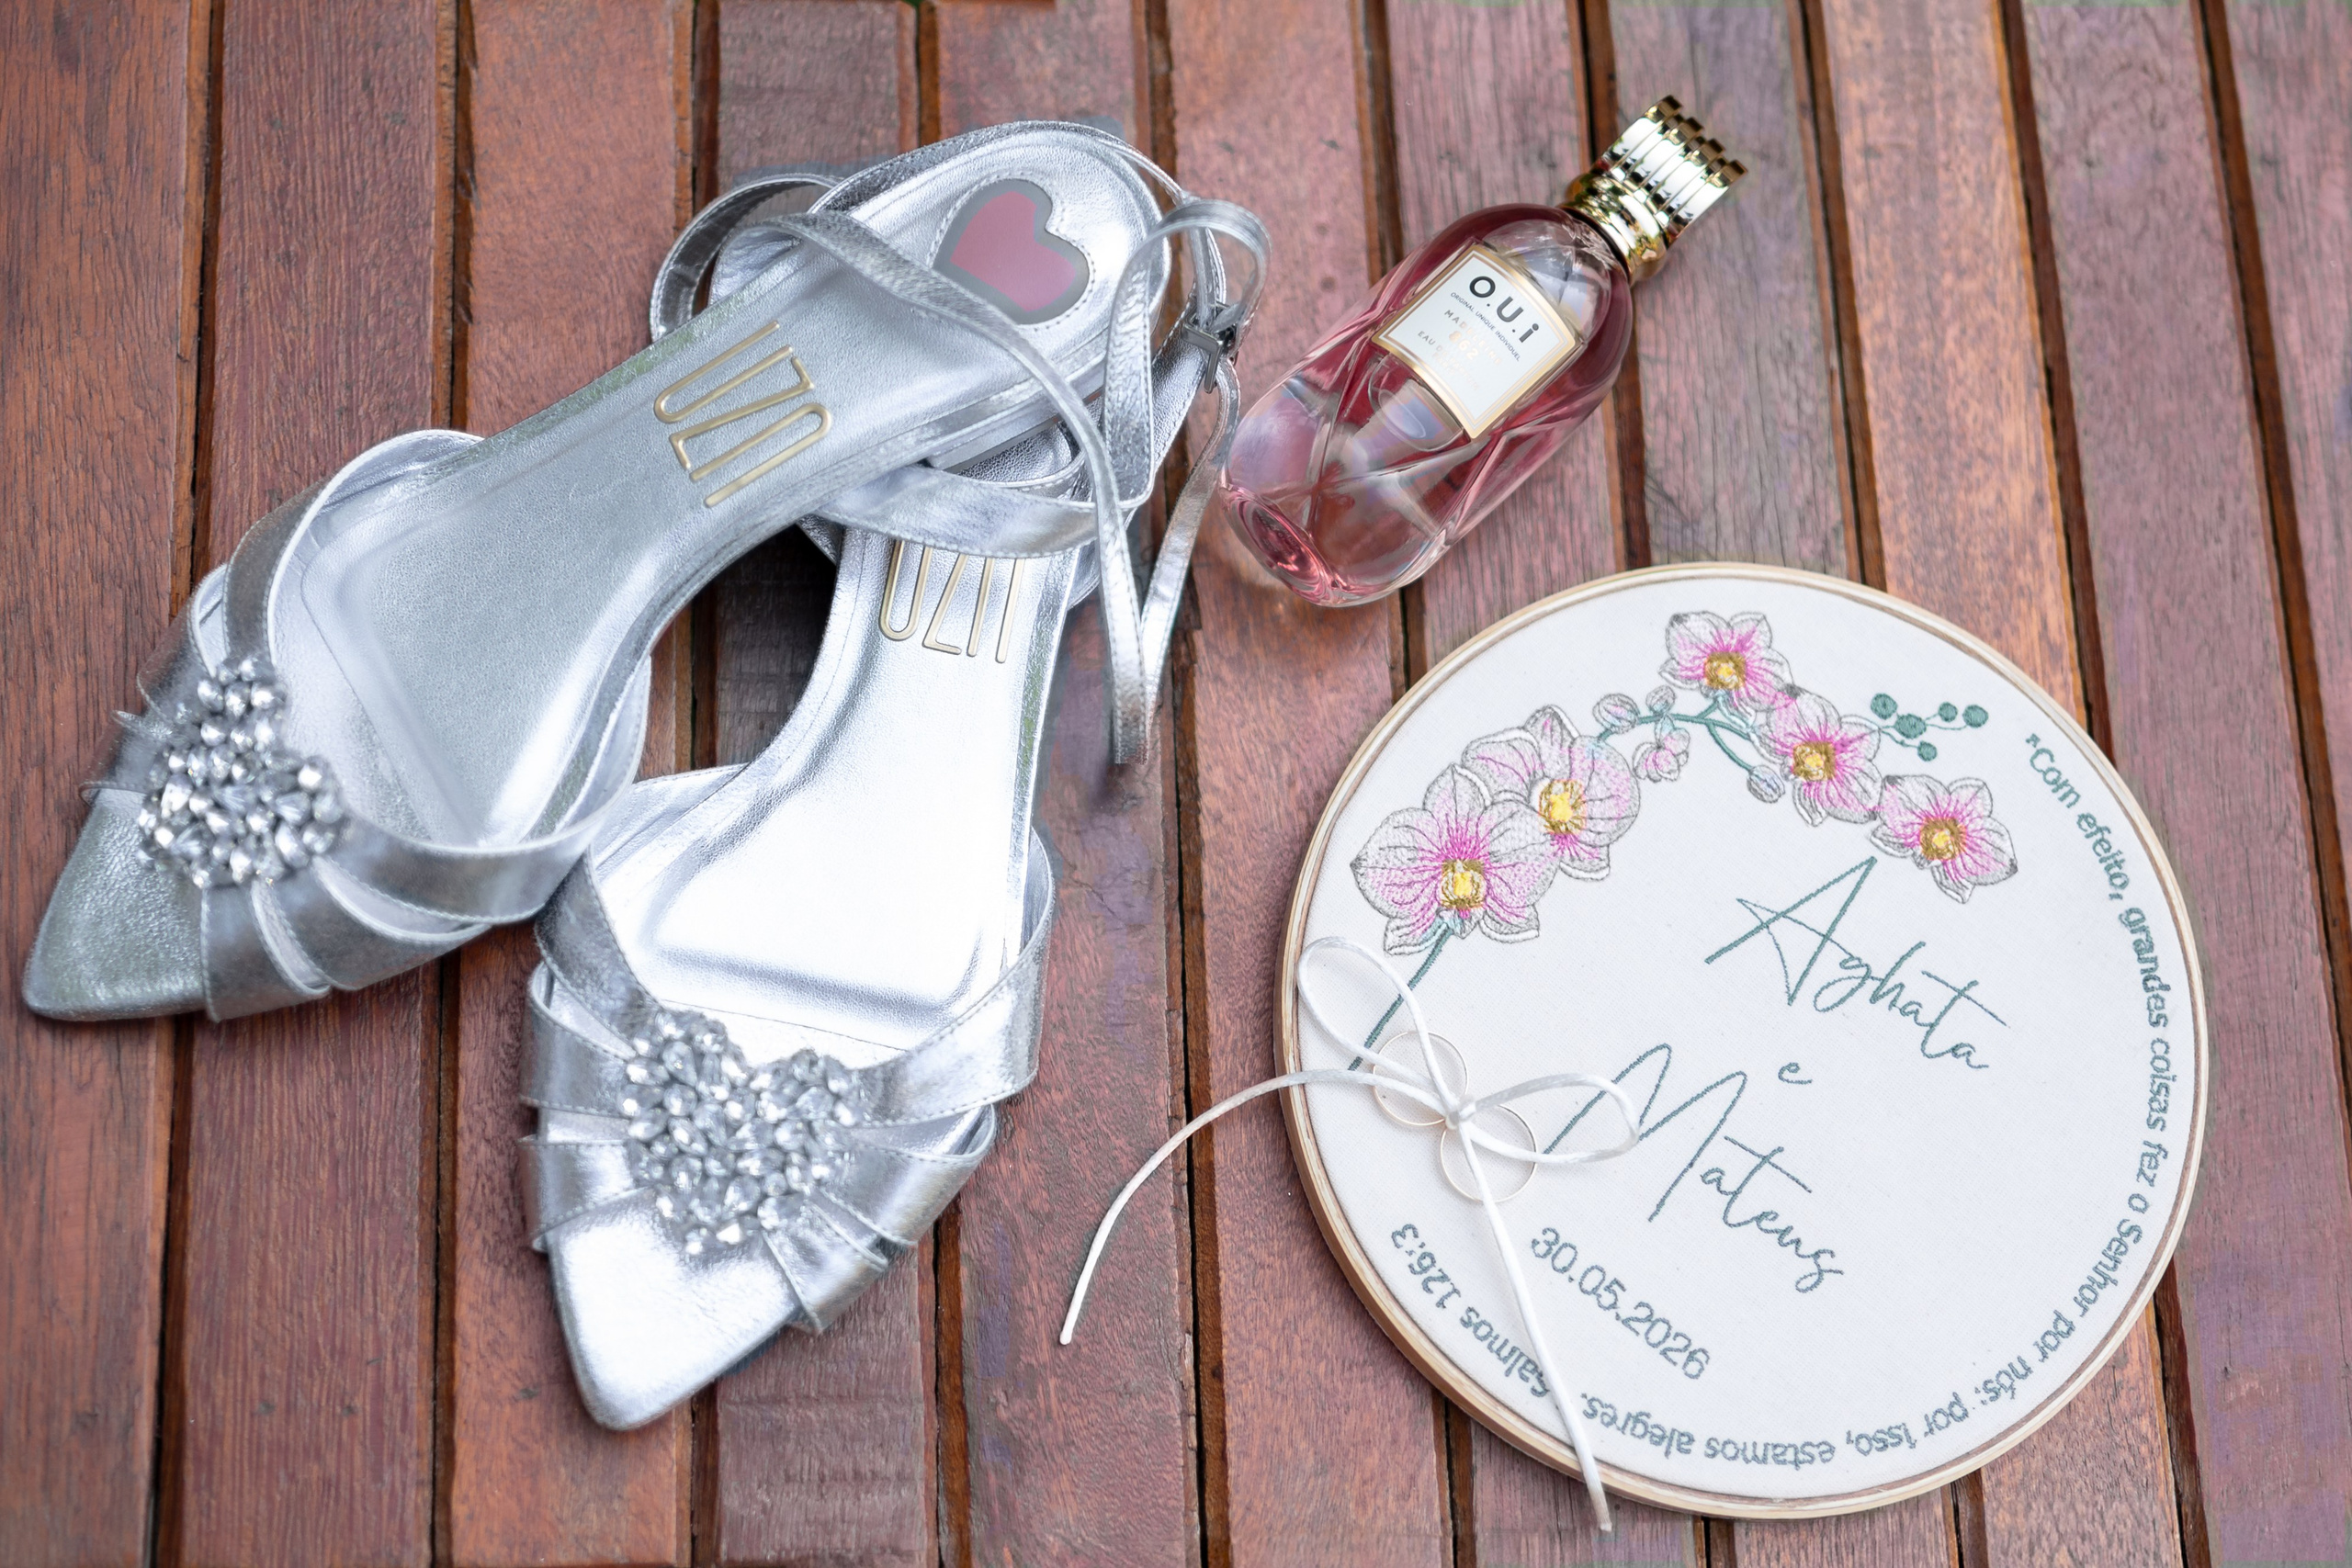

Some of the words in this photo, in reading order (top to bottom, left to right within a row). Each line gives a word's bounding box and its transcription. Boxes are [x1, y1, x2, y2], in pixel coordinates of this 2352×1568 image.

[1417, 330, 1436, 345] EAU
[1443, 309, 1503, 366] MADELEINE
[1448, 330, 1479, 361] 862
[1450, 291, 1476, 314] ORIGINAL
[1475, 310, 1496, 332] UNIQUE
[1494, 330, 1521, 362] INDIVIDUEL
[2076, 812, 2130, 900] efeito,
[1704, 855, 2009, 1070] Aghata
[2119, 908, 2171, 1028] grandes
[1778, 1062, 1813, 1084] e
[2146, 1037, 2177, 1131] coisas
[1542, 1043, 1844, 1293] Mateus
[2136, 1140, 2168, 1187] fez
[1390, 1223, 1462, 1310] 126:3
[2073, 1218, 2143, 1317] Senhor
[1531, 1226, 1711, 1381] 30.05.2026
[2033, 1310, 2075, 1362] por
[1845, 1422, 1918, 1456] isso,
[1923, 1392, 1970, 1438] por
[1704, 1437, 1836, 1471] estamos
